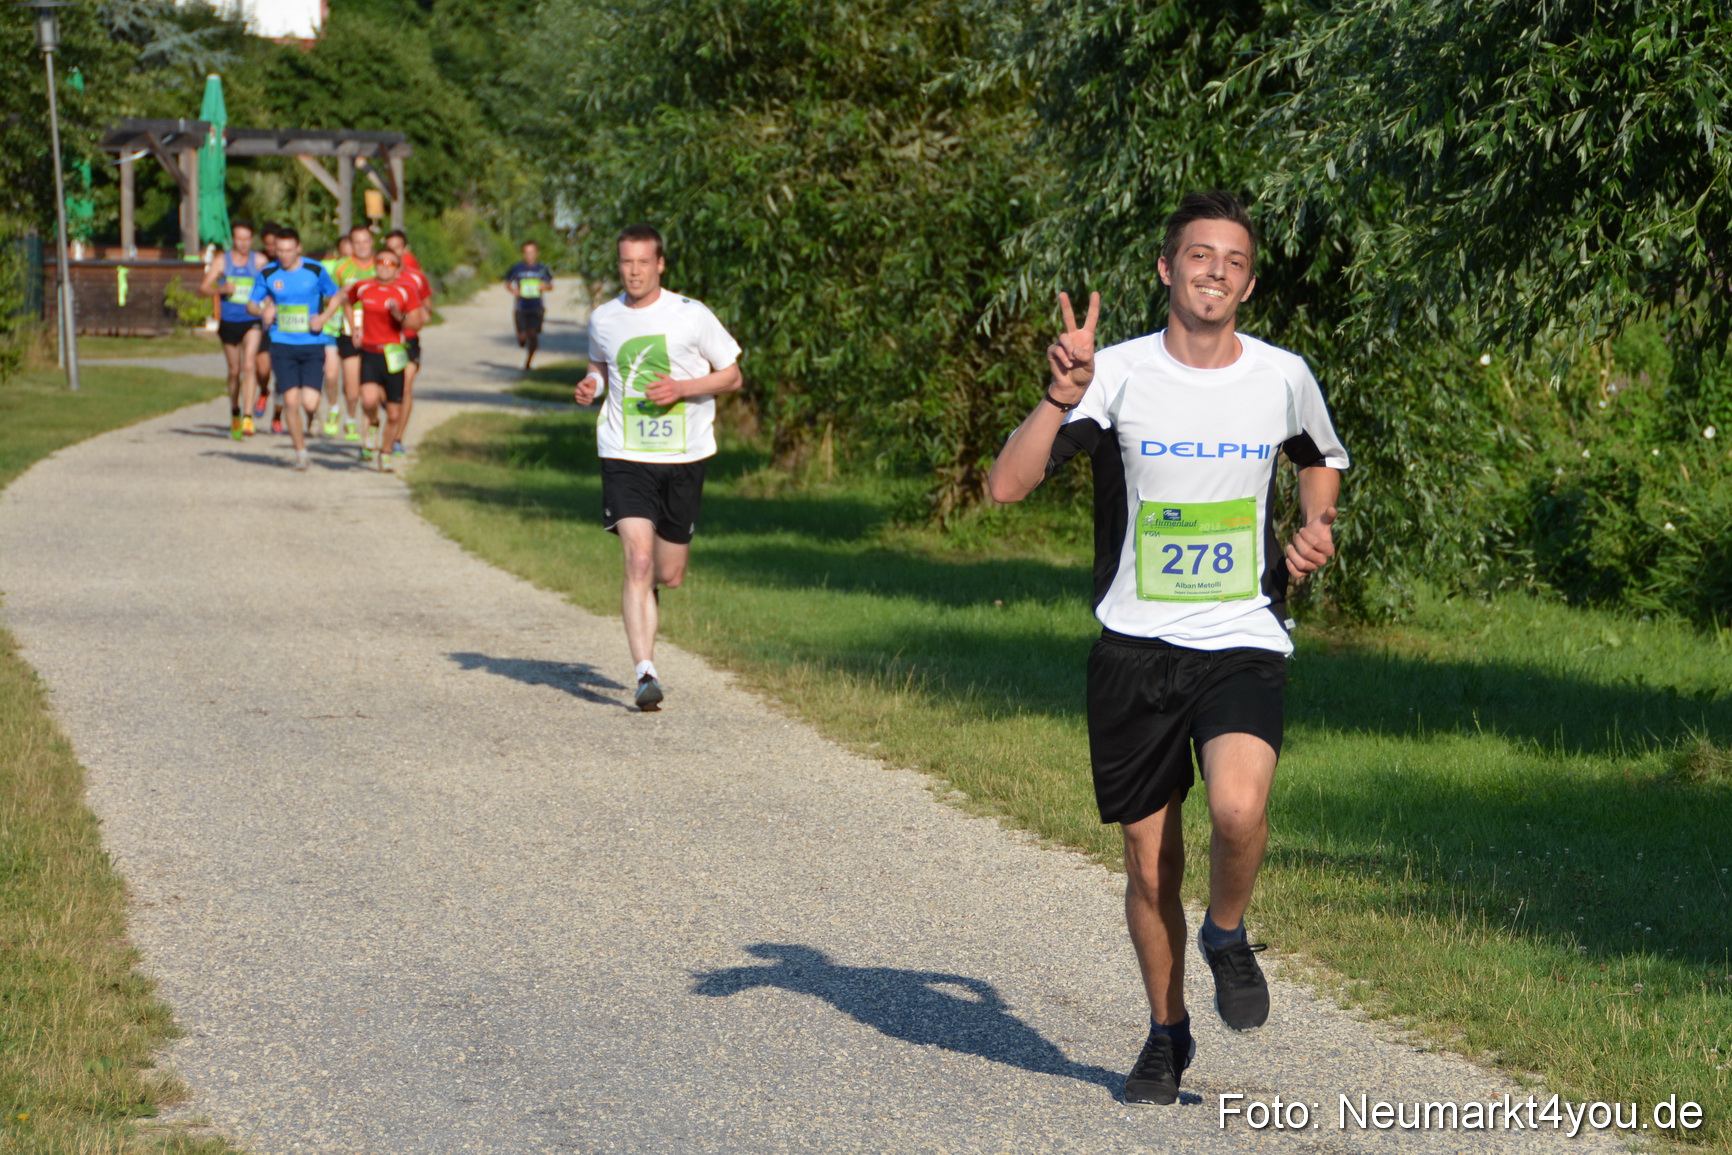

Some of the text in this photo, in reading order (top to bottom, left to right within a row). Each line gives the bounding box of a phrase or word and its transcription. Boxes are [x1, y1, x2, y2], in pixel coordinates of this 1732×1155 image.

[636, 420, 673, 437] 125
[1141, 440, 1270, 460] DELPHI
[1161, 542, 1234, 575] 278
